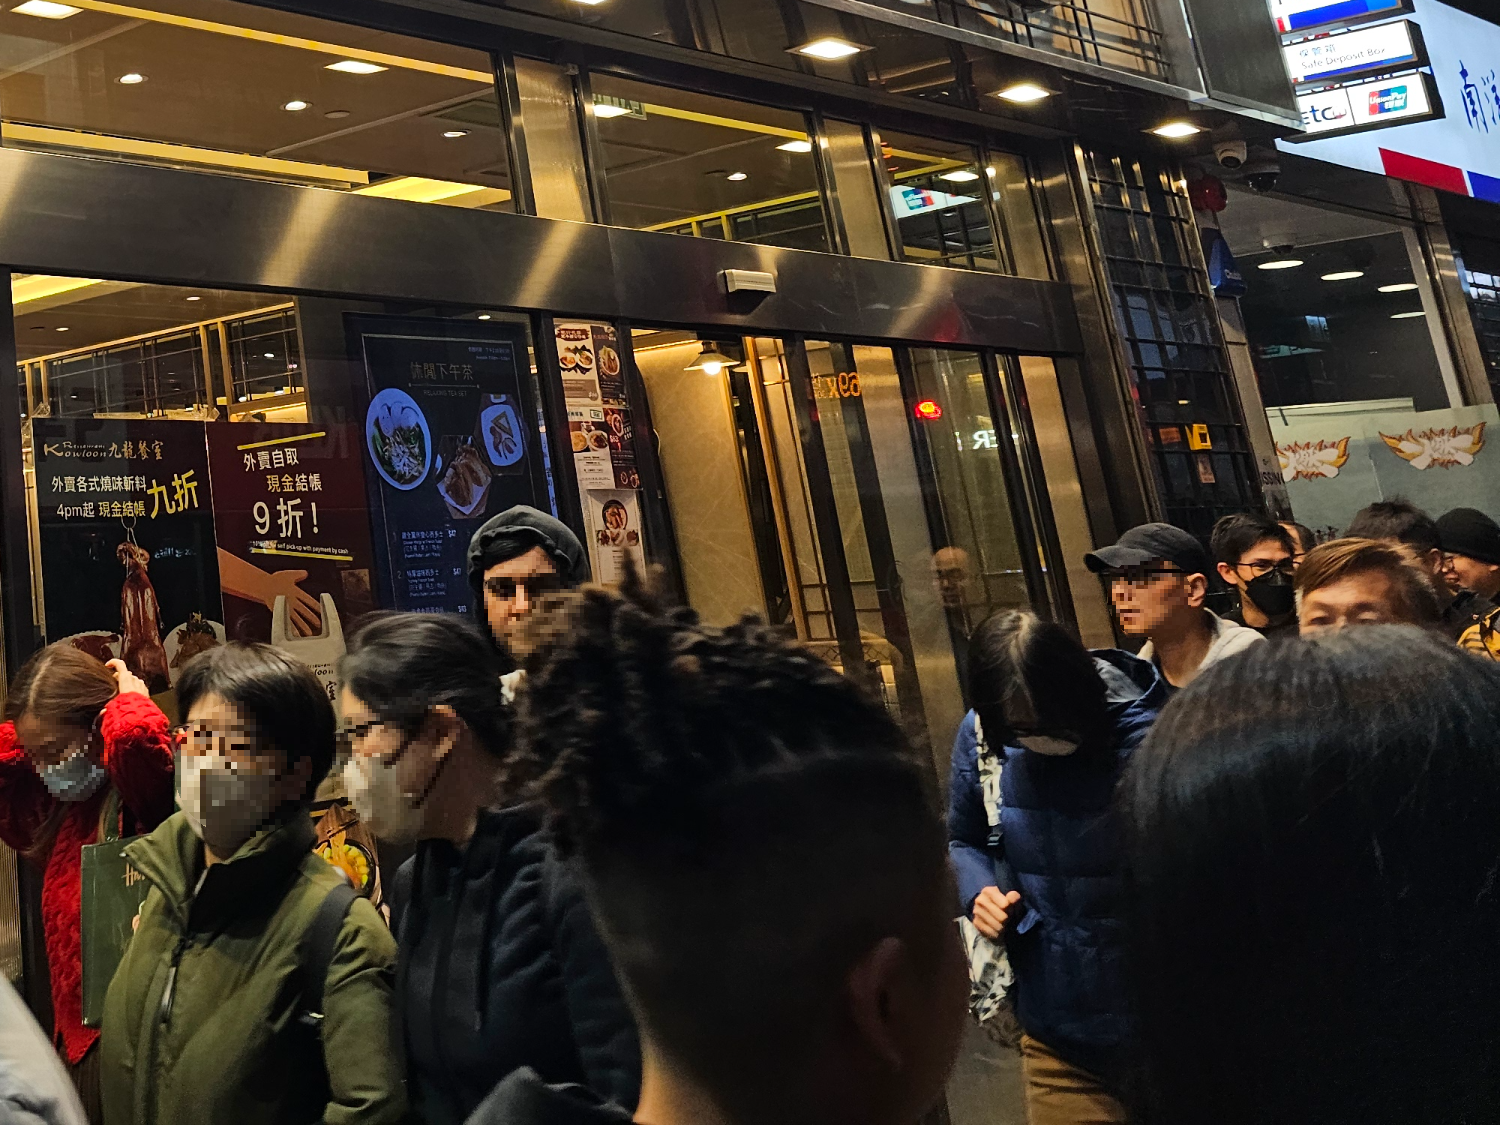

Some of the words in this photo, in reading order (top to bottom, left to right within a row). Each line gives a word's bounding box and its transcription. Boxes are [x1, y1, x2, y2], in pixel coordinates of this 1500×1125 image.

[1302, 57, 1323, 70] Safe
[1325, 50, 1364, 65] Deposit
[43, 442, 107, 458] Kowloon
[108, 440, 164, 461] 九龍餐室
[243, 447, 300, 472] 外賣自取
[51, 475, 147, 493] 外賣各式燒味斬料
[266, 473, 323, 493] 現金結帳
[146, 469, 199, 520] 九折
[56, 501, 95, 521] 4pm起
[98, 500, 146, 518] 現金結帳
